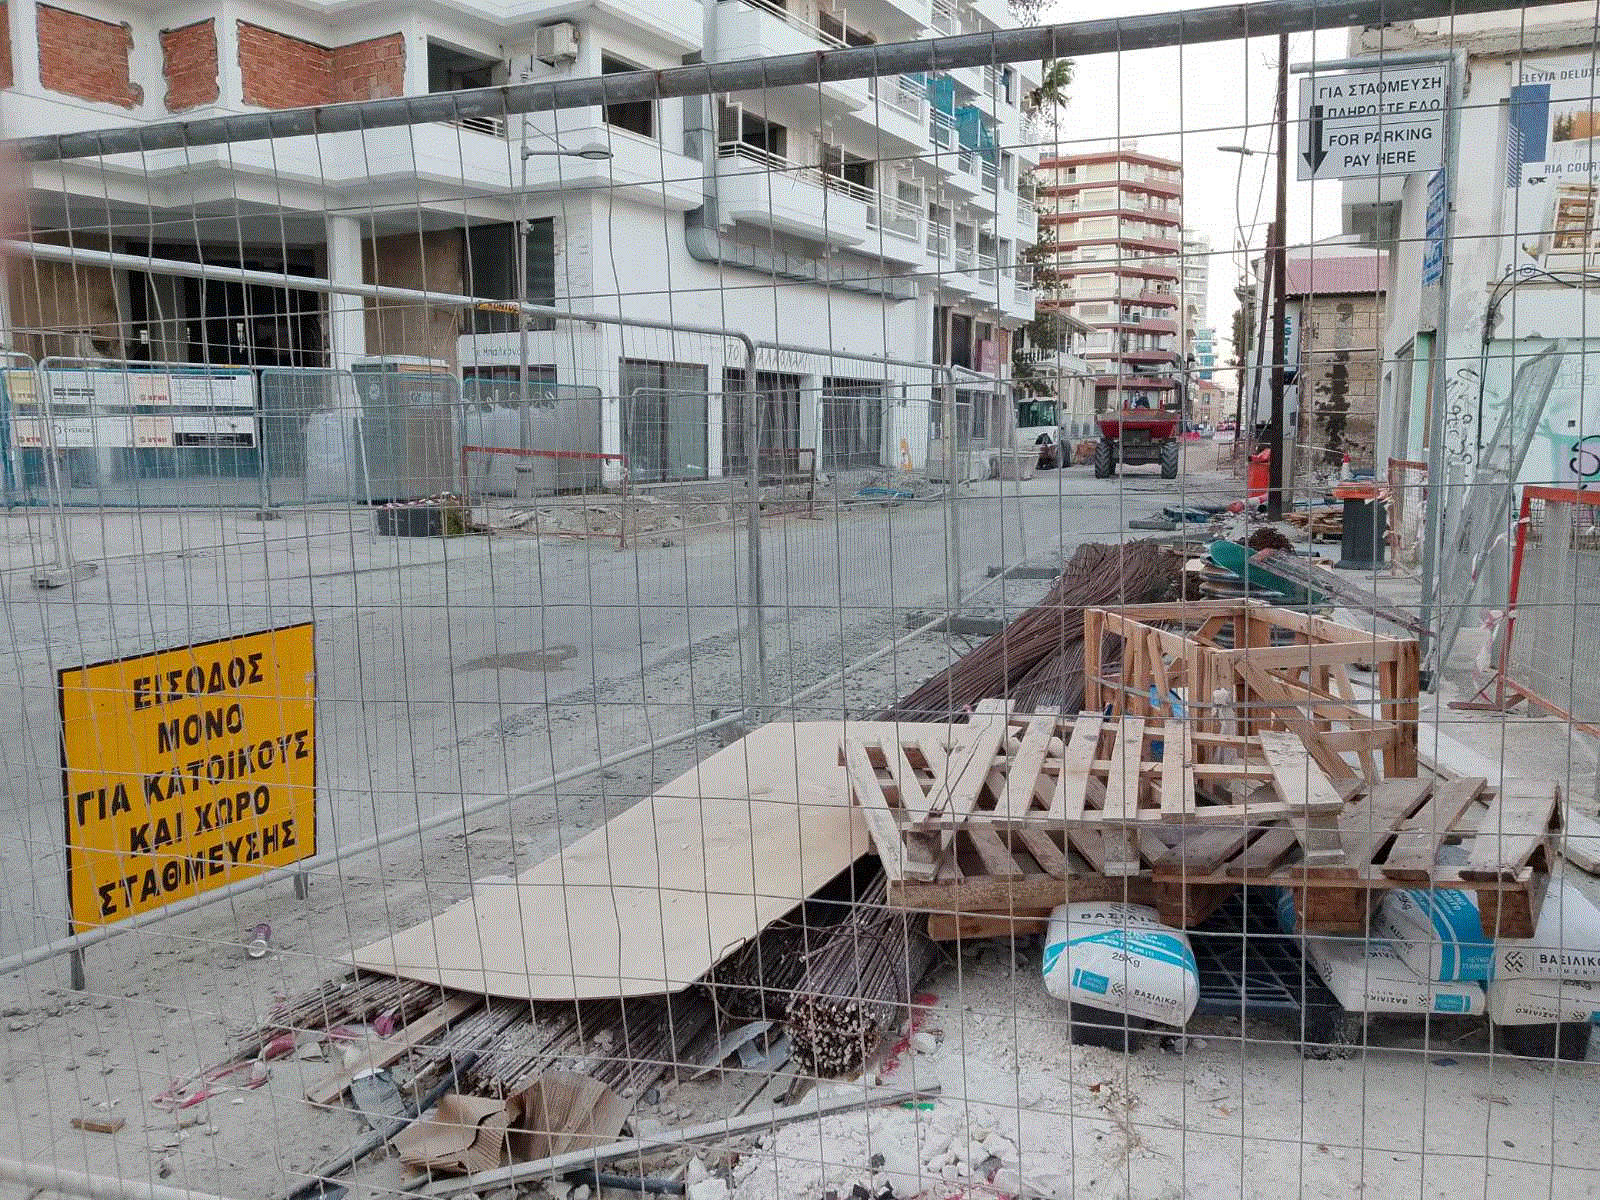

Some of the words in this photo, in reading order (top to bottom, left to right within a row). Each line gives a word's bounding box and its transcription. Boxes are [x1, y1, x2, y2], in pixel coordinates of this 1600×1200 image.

[1319, 87, 1343, 99] ΓΙΑ
[1348, 76, 1442, 97] ΣΤΑΘΜΕΥΣΗ
[1329, 133, 1359, 147] FOR
[1364, 127, 1432, 144] PARKING
[1344, 154, 1371, 168] PAY
[1376, 150, 1417, 165] HERE
[133, 653, 264, 711] ΕΙΣΟΔΟΣ
[158, 704, 243, 754] ΜΟΝΟ
[77, 783, 131, 827] ΓΙΑ
[143, 730, 309, 806] ΚΑΤΟΙΚΟΥΣ
[130, 813, 183, 858] ΚΑΙ
[195, 785, 270, 837] ΧΩΡΟ
[98, 819, 296, 917] ΣΤΑΘΜΕΥΣΗΣ
[1111, 952, 1141, 968] 25Kg
[1134, 989, 1177, 1005] ΒΑΣΙΛΙΚΟ
